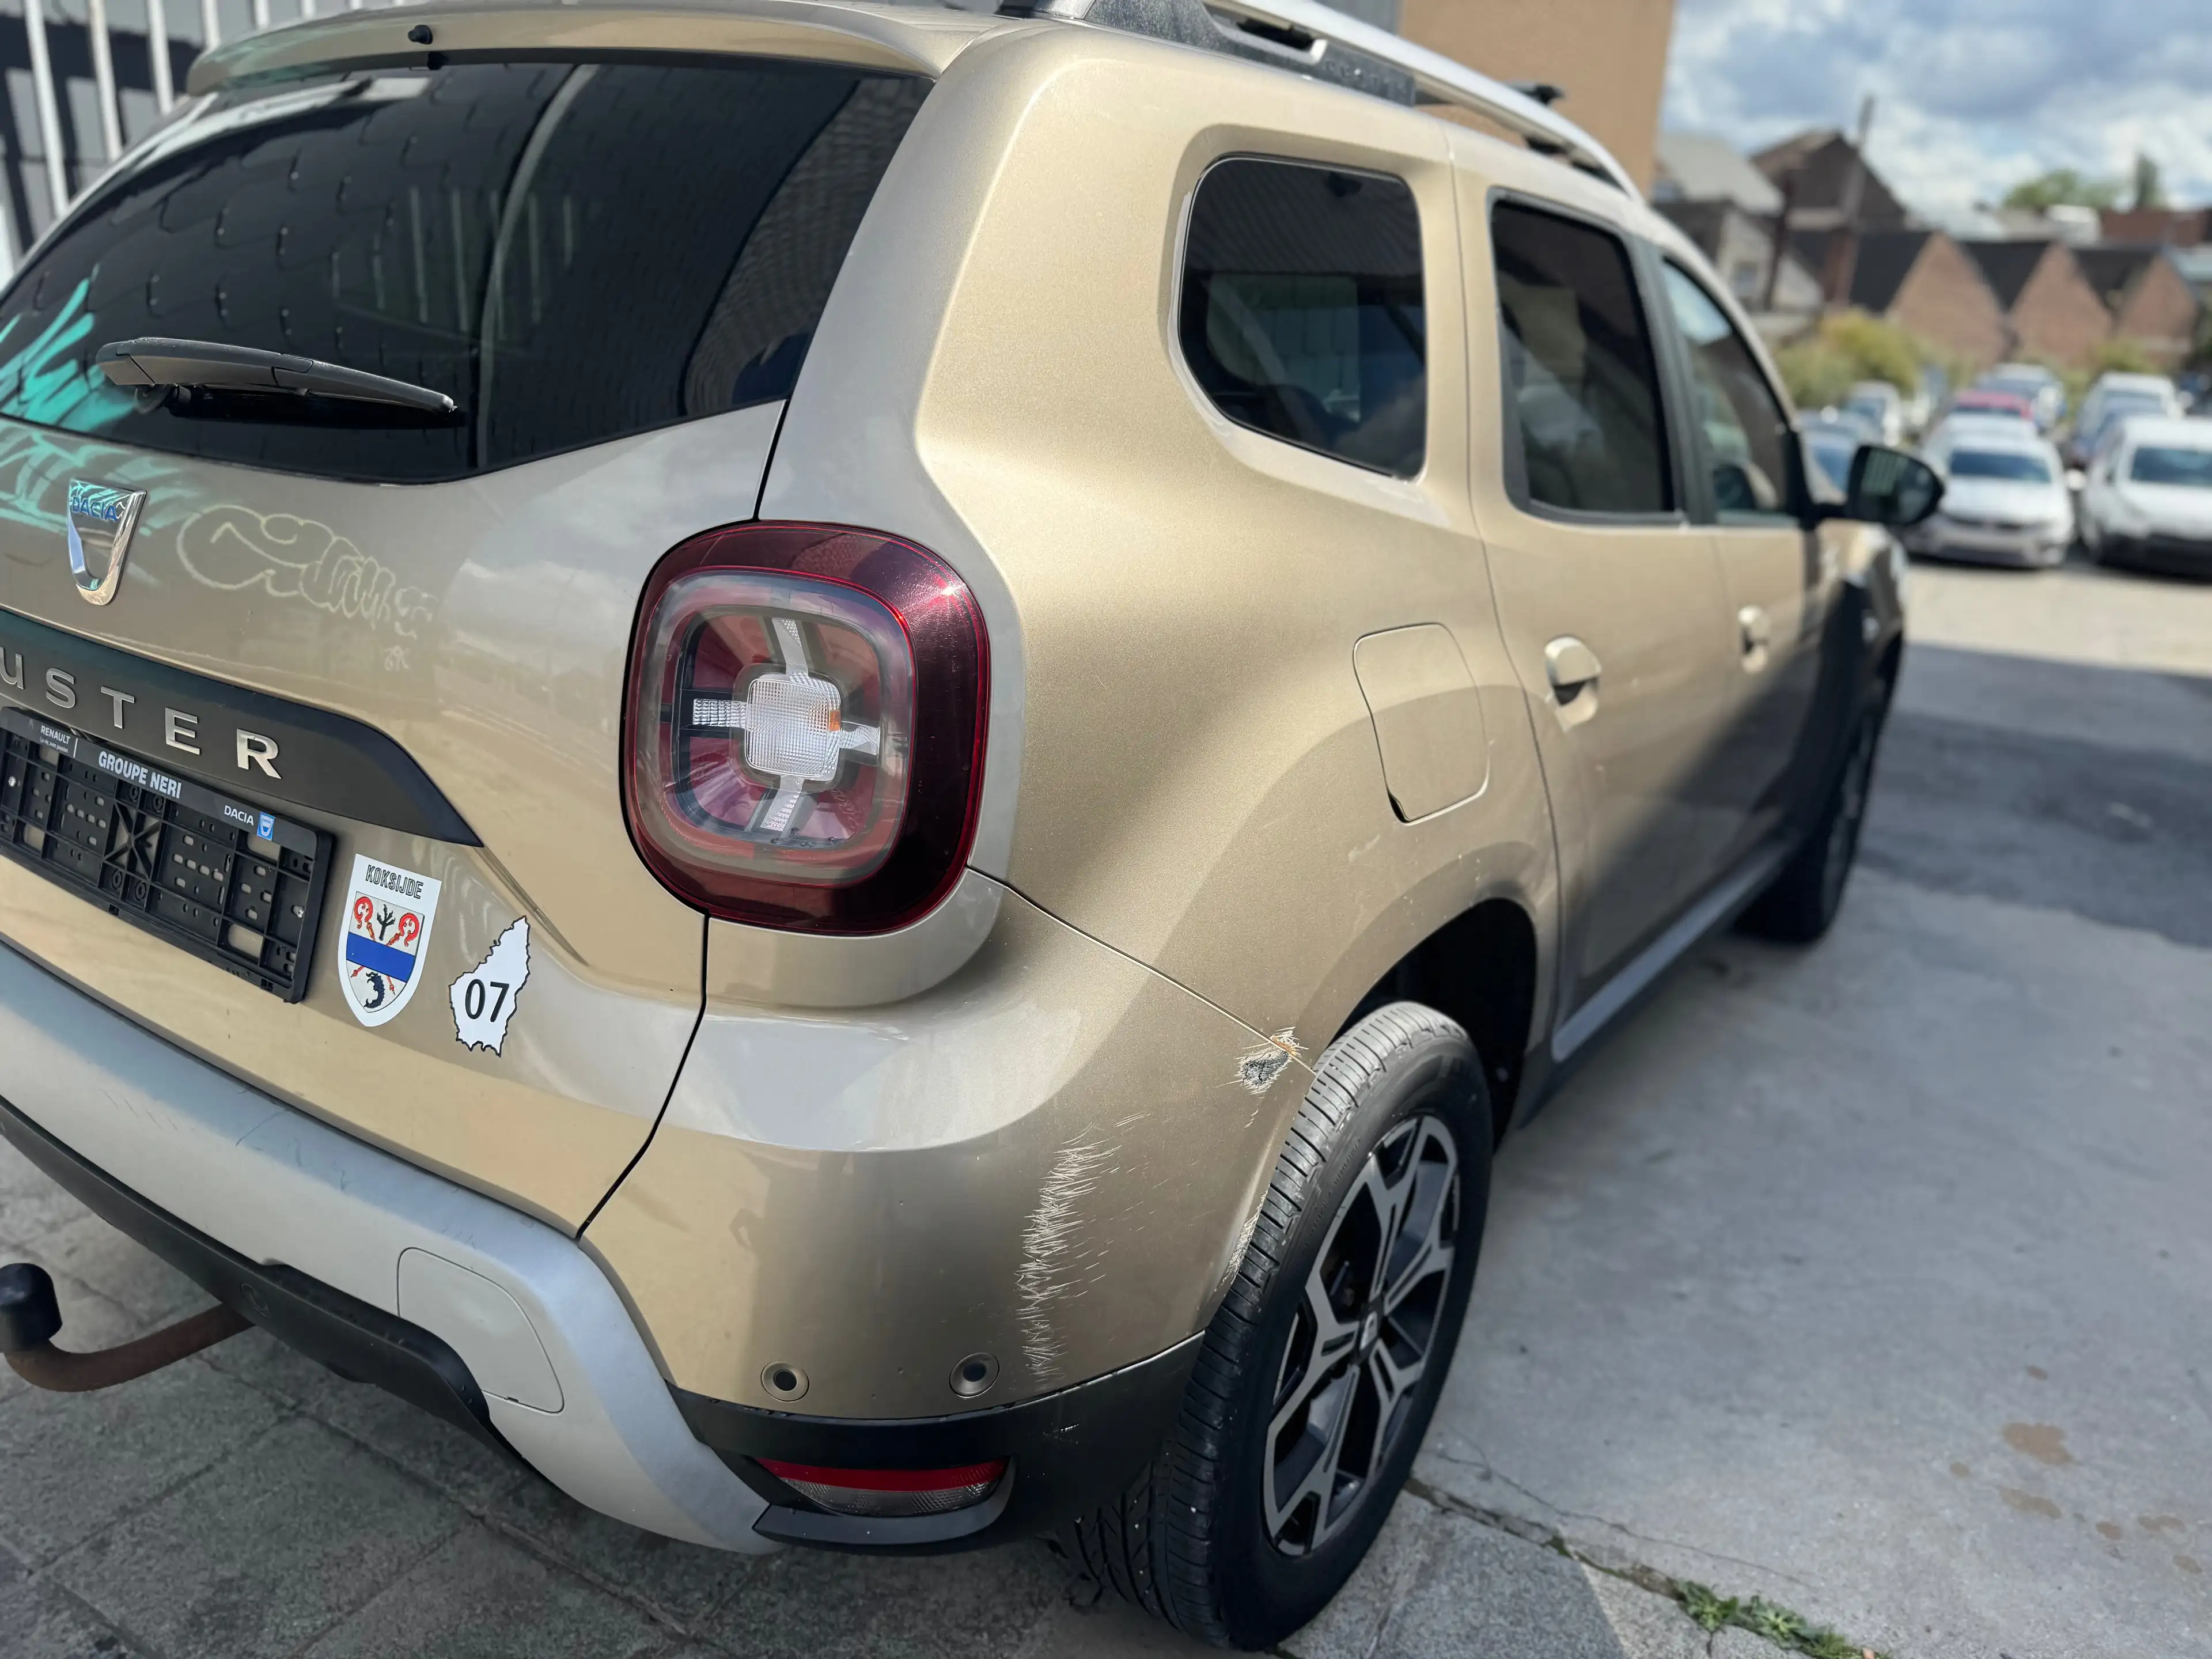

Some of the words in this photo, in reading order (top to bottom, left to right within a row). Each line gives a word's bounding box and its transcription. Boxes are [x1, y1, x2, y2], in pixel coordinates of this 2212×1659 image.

[71, 496, 118, 522] DACIA
[41, 725, 70, 745] RENAULT
[99, 751, 149, 785] GROUPE
[150, 772, 182, 799] NERI
[224, 805, 254, 826] DACIA
[365, 865, 424, 900] KOKSIJDE
[465, 979, 510, 1023] 07
